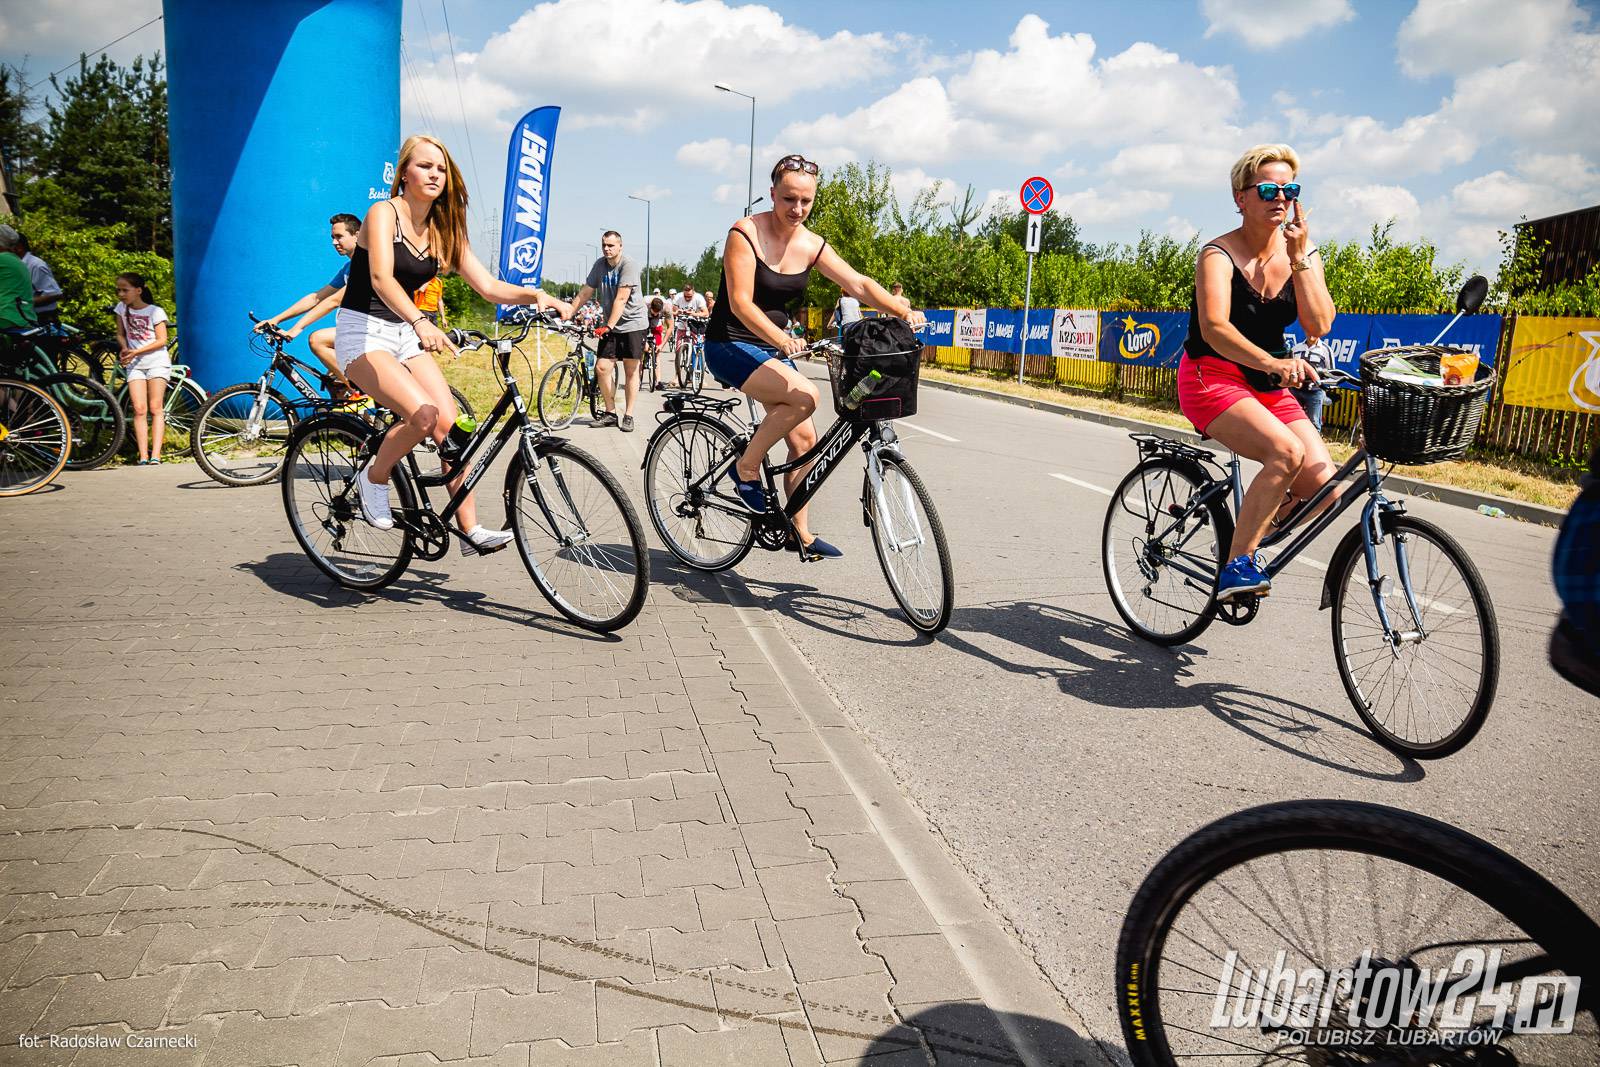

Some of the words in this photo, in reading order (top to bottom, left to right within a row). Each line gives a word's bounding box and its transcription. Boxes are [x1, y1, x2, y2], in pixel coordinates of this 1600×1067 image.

[515, 128, 548, 232] MAPEI
[1029, 324, 1050, 340] MAPEI
[1127, 330, 1153, 352] LOTTO
[805, 423, 853, 491] KANDS
